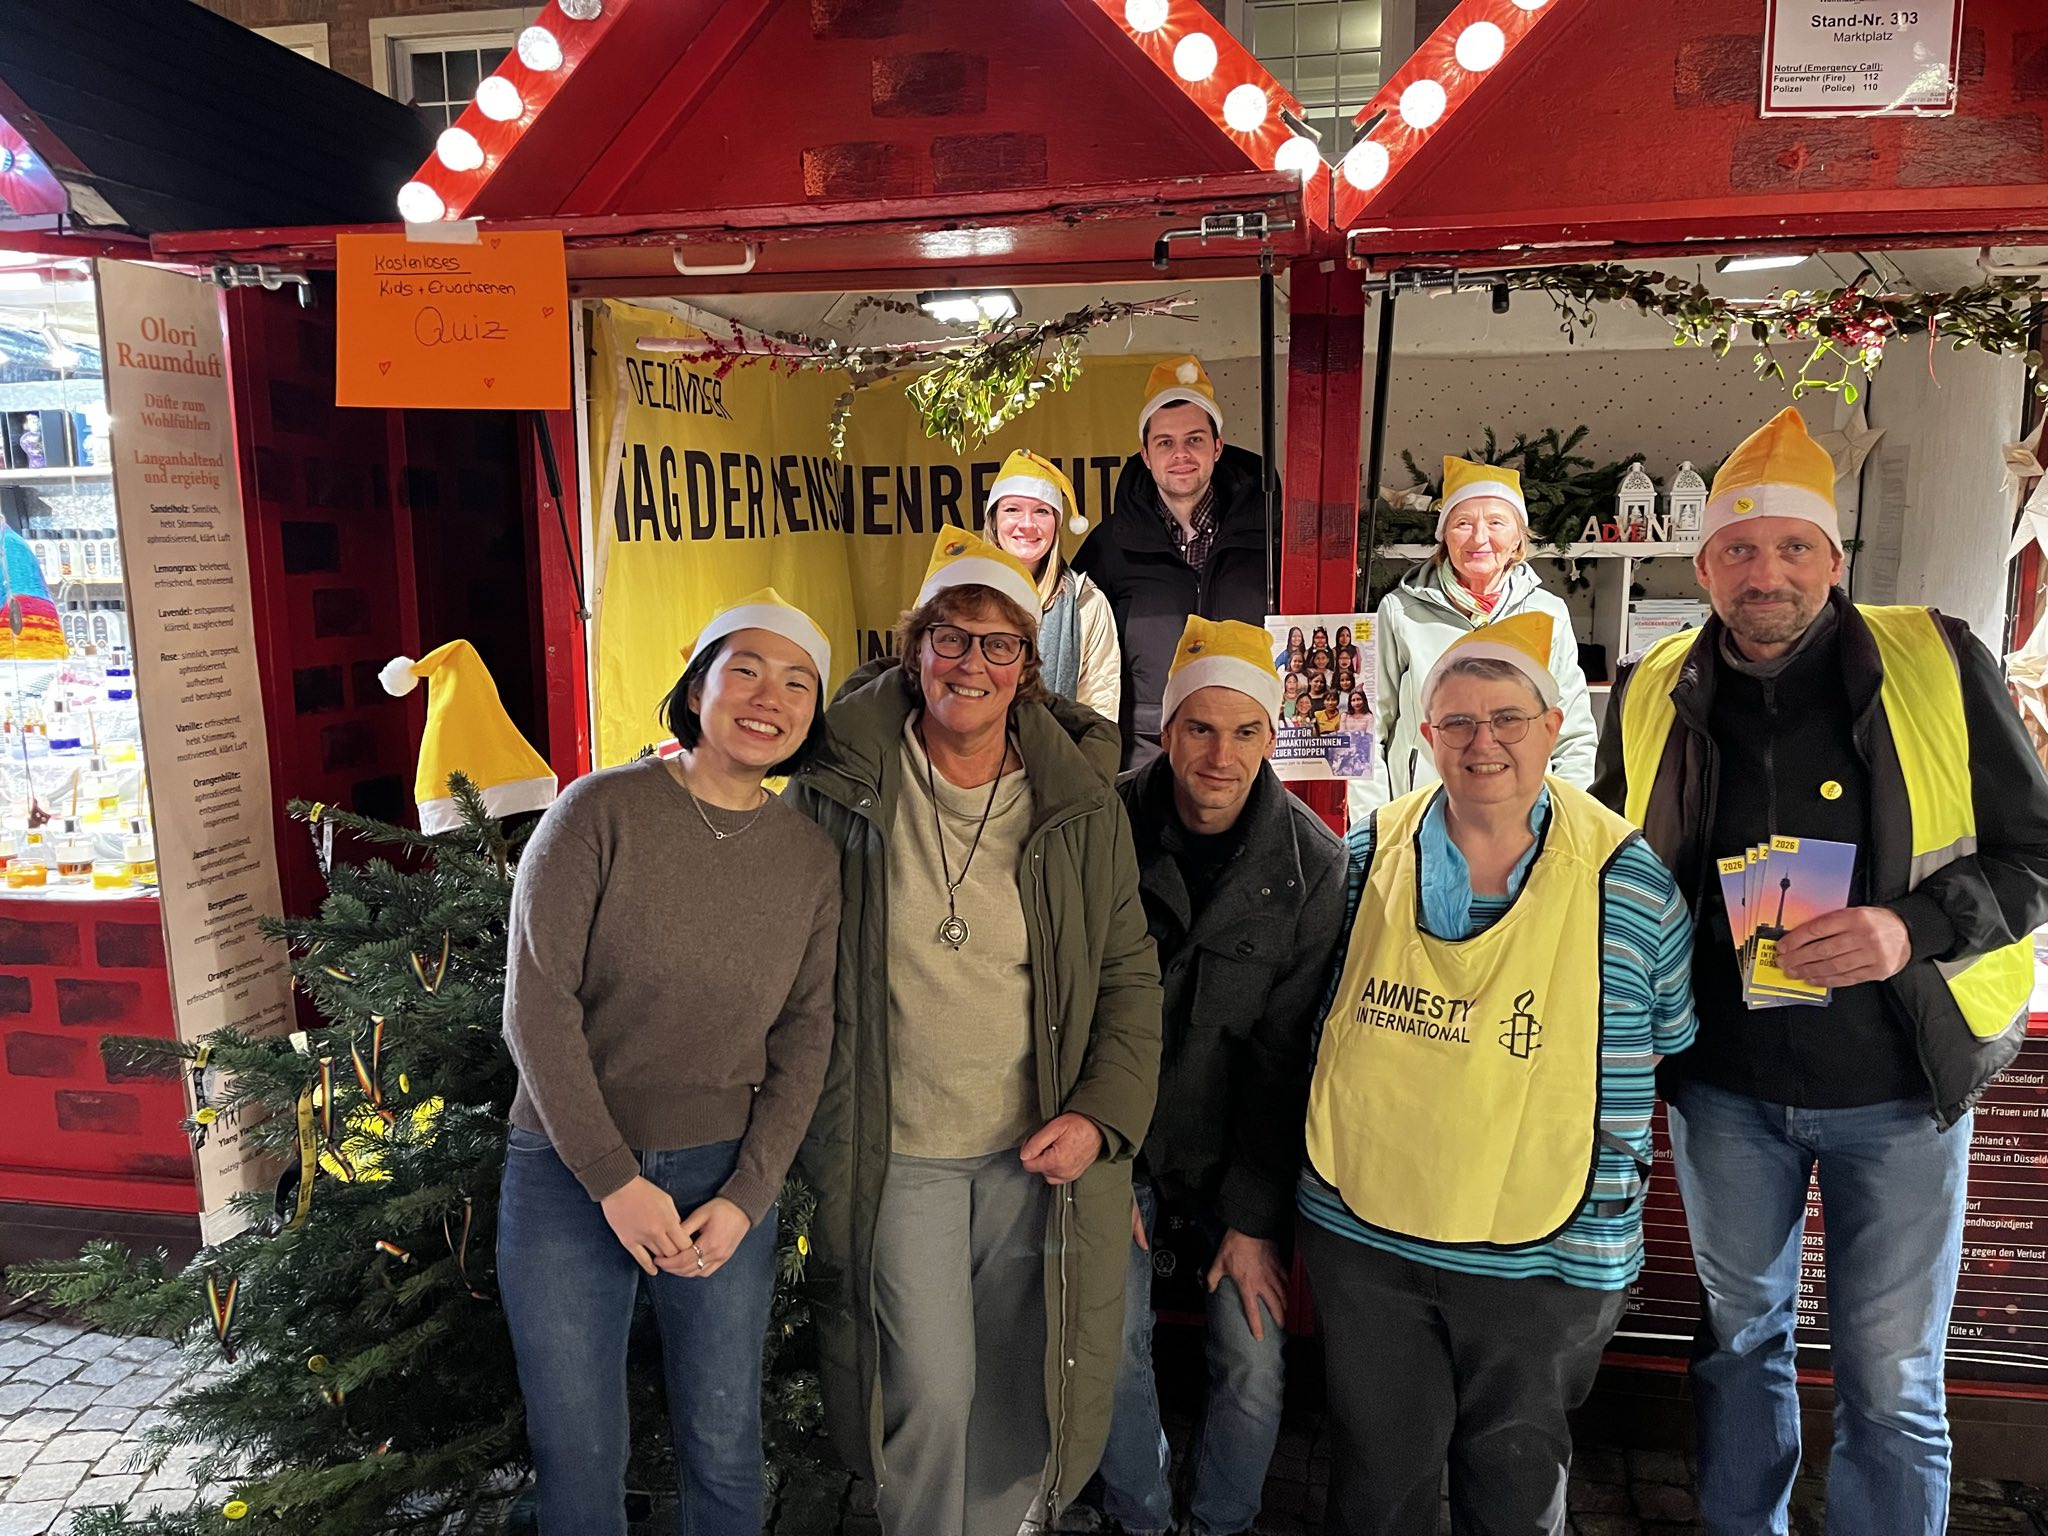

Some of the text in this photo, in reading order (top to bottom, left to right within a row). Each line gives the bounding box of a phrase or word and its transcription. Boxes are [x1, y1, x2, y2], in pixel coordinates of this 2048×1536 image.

[1811, 13, 1885, 28] Stand-Nr.
[1833, 31, 1893, 43] Marktplatz
[1774, 62, 1883, 73] Notruf (Emergency Call):
[1773, 73, 1879, 83] Feuerwehr (Fire) 112
[1773, 85, 1802, 93] Polizei
[1821, 84, 1855, 93] (Police)
[380, 281, 414, 297] Kids
[140, 316, 197, 347] Olori
[414, 306, 509, 347] Quiz
[116, 342, 222, 378] Raumduft
[144, 393, 206, 412] Düfte zum
[141, 412, 210, 431] Wohlfühlen
[134, 450, 223, 472] Langanhaltend
[144, 469, 220, 489] und ergiebig
[684, 449, 765, 540] DER
[1298, 728, 1312, 737] FÜR
[1276, 738, 1342, 747] LIMAAKTIVISTINNEN
[1293, 748, 1325, 756] STOPPEN
[1775, 840, 1795, 850] 2026
[1723, 861, 1743, 871] 2026
[1361, 977, 1476, 1023] AMNESTY
[1356, 1006, 1470, 1043] INTERNATIONAL
[1998, 1073, 2044, 1084] Düsseldorf
[1991, 1107, 2020, 1117] Frauen
[2022, 1109, 2038, 1117] und
[2003, 1153, 2011, 1162] in
[1802, 1252, 1823, 1262] 2025
[1971, 1247, 1997, 1257] gegen
[1999, 1248, 2014, 1257] den
[2017, 1249, 2045, 1259] Verlust
[1797, 1300, 1819, 1309] 2025
[1950, 1326, 1967, 1335] Tüte
